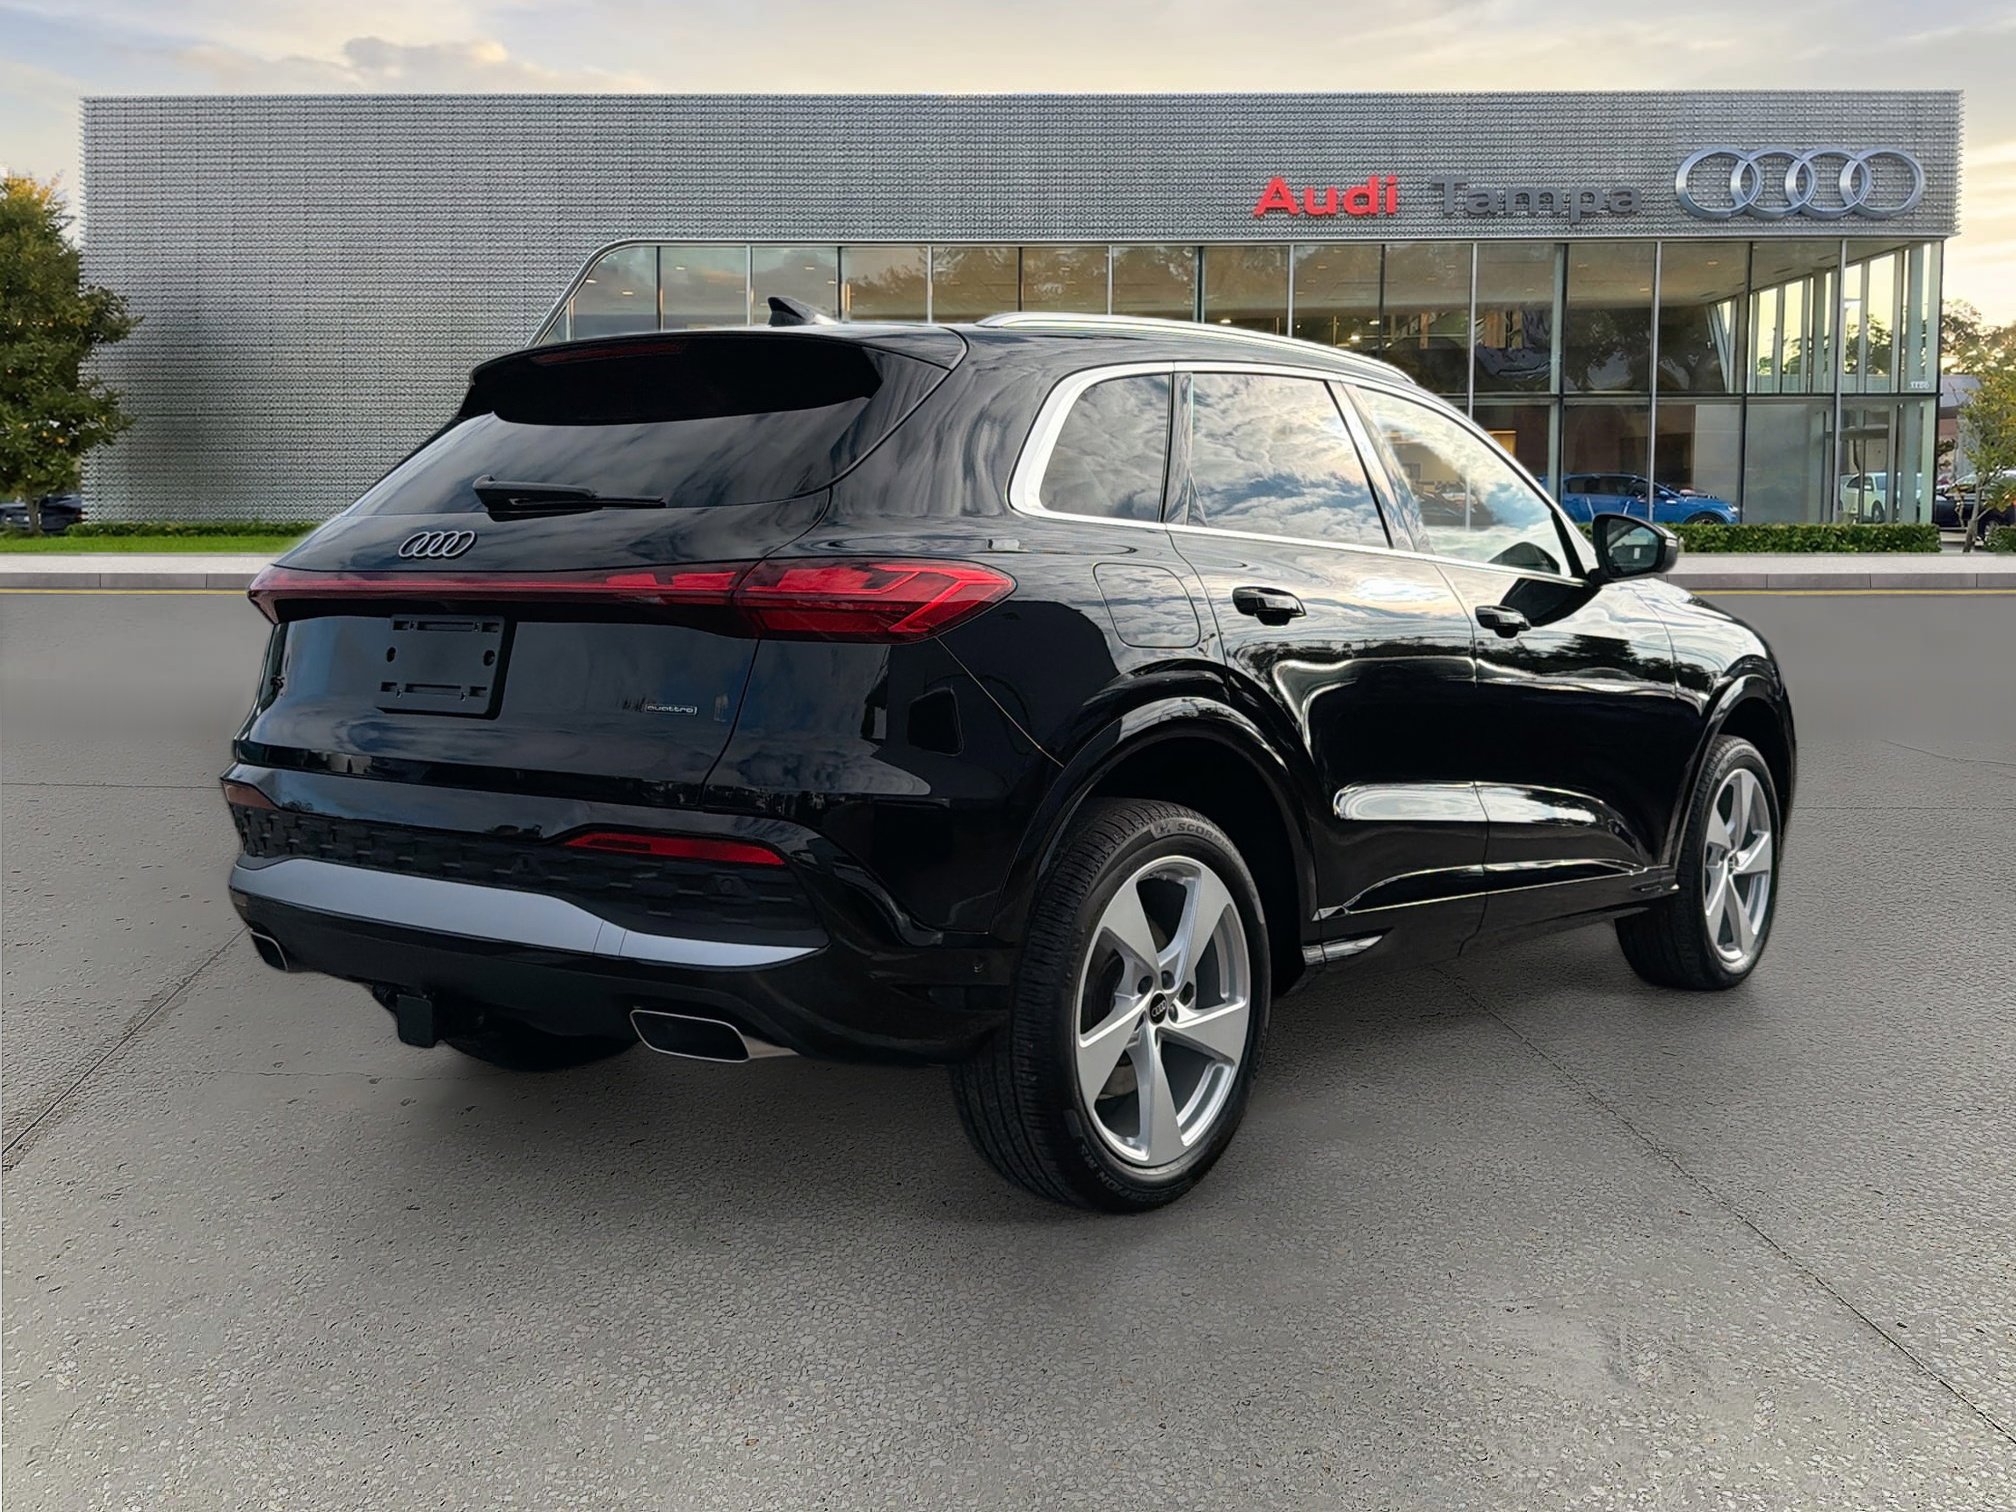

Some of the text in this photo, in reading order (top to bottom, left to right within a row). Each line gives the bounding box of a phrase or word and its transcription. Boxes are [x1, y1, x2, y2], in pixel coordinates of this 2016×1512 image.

[1254, 175, 1643, 225] Audi Tampa
[647, 704, 694, 714] quattro
